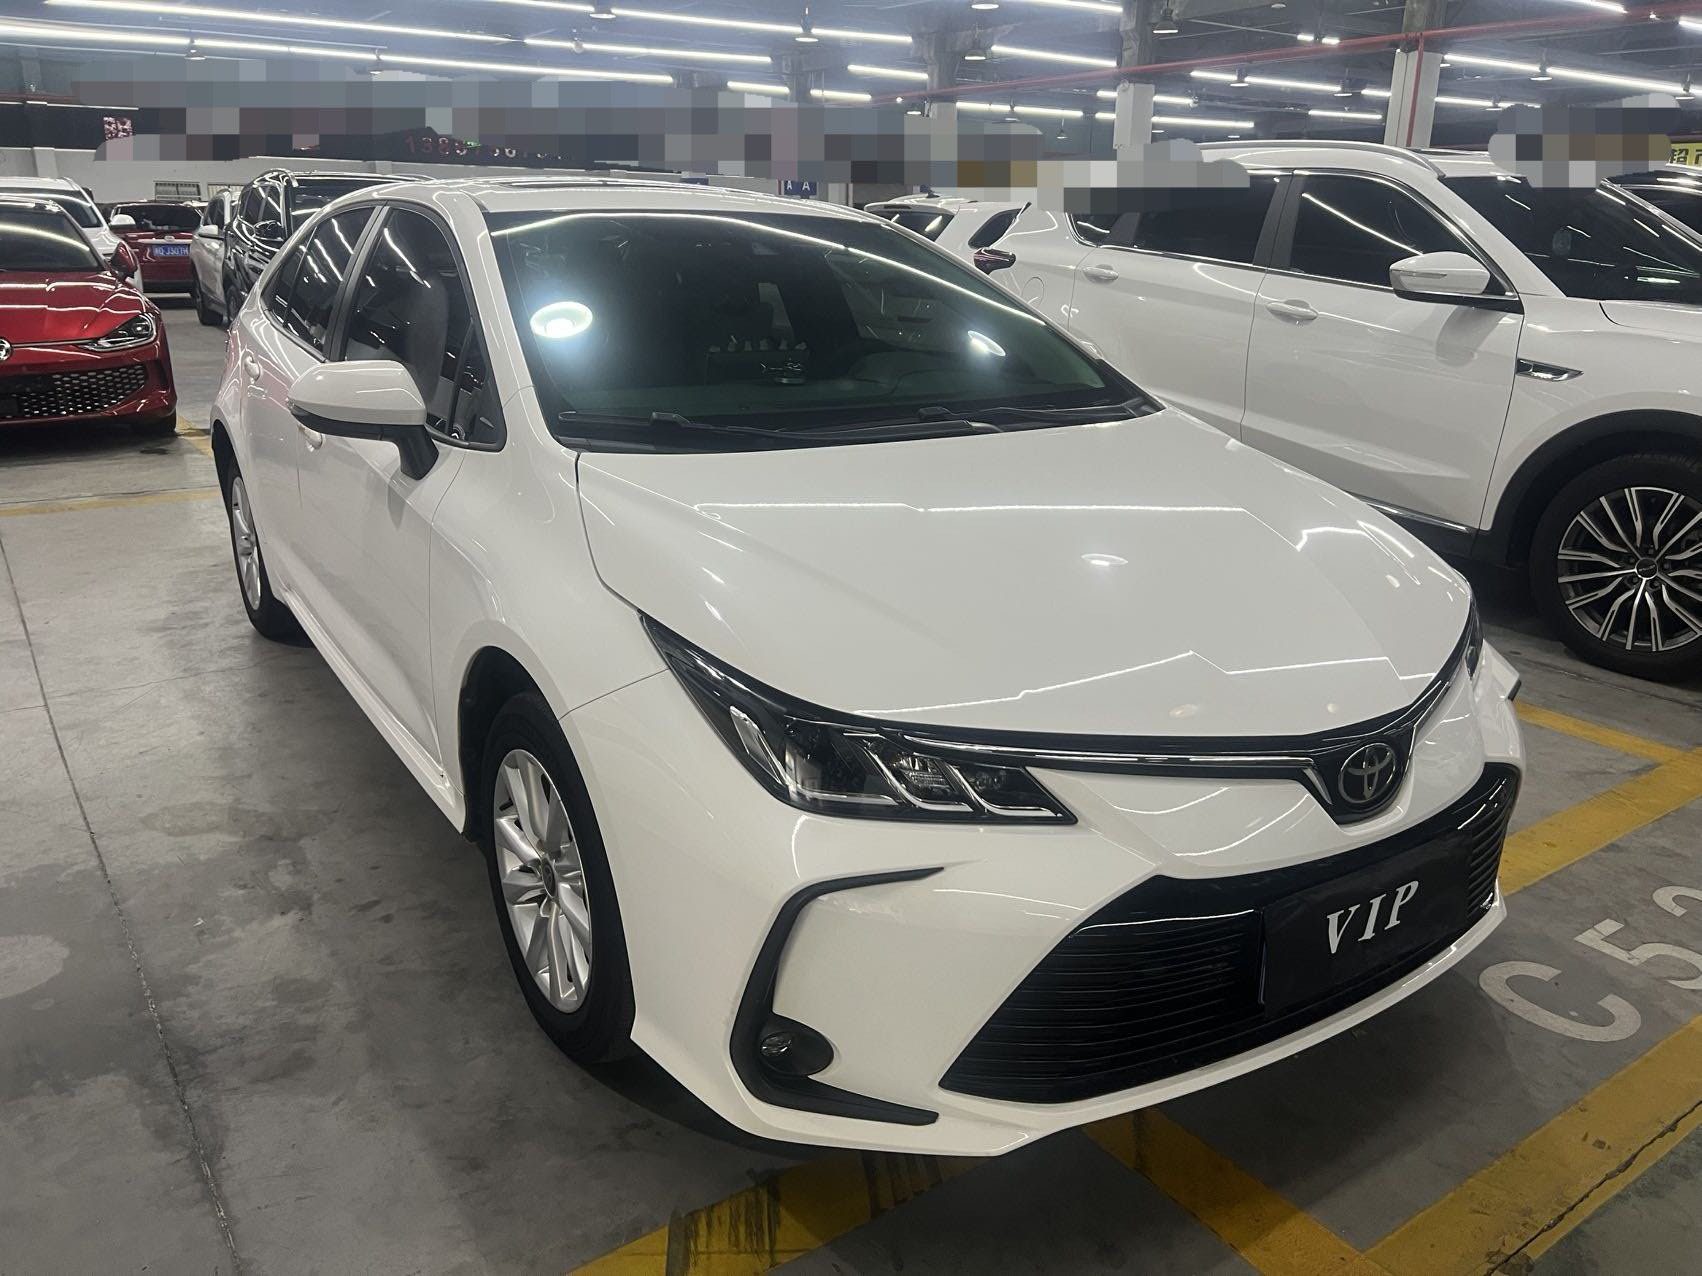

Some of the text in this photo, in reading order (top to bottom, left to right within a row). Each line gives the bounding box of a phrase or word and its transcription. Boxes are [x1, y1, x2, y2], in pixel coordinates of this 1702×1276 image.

[786, 180, 793, 190] A
[802, 181, 811, 191] A
[1327, 881, 1419, 954] VIP
